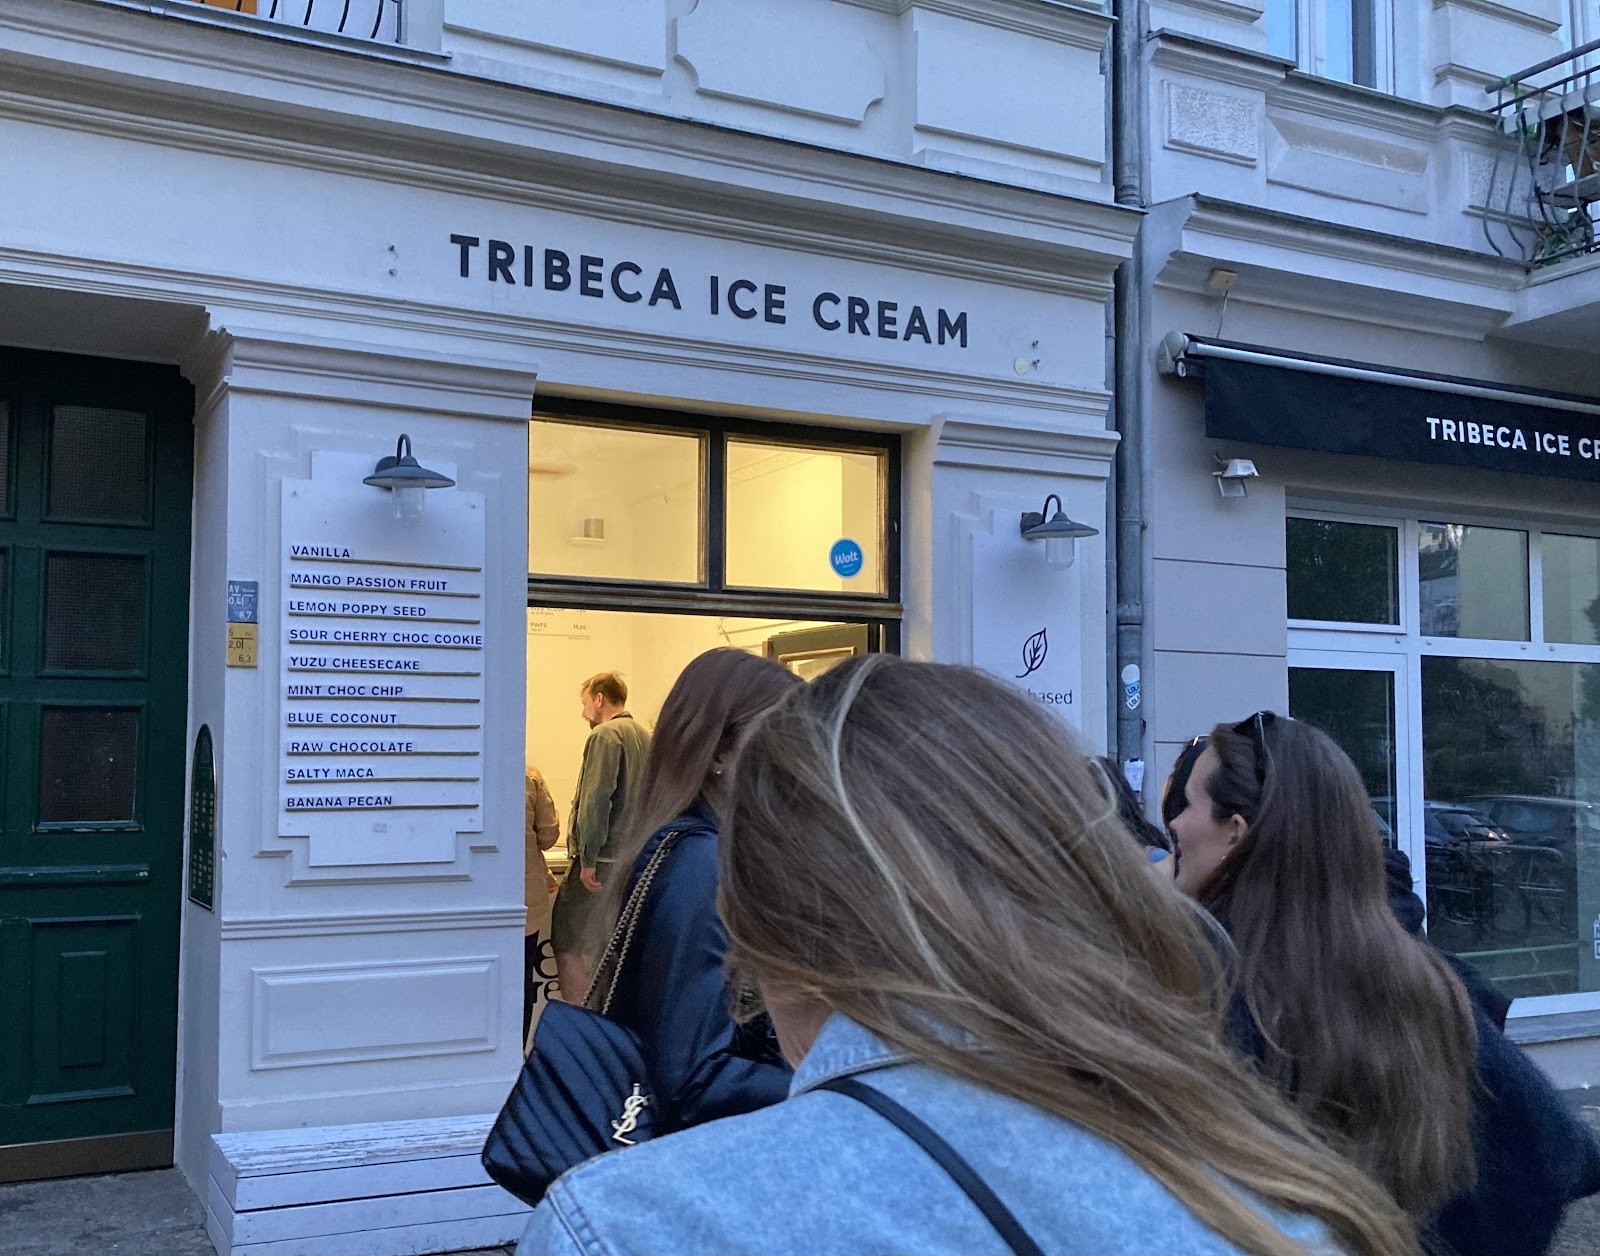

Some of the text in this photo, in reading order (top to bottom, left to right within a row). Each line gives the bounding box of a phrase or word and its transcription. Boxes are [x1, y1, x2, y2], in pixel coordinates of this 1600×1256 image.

[450, 233, 968, 348] TRIBECA ICE CREAM
[1426, 416, 1527, 451] TRIBECA
[1535, 431, 1571, 456] ICE
[292, 545, 351, 558] VANILLA
[834, 550, 859, 565] Wolt
[291, 573, 448, 591] MANGO PASSION FRUIT
[289, 600, 426, 617] LEMON POPPY SEED
[290, 629, 482, 645] SOUR CHERRY CHOC COOKIE
[290, 656, 420, 670] YUZU CHEESECAKE
[288, 685, 403, 696] MINT CHOC CHIP
[288, 712, 397, 724] BLUE COCONUT
[291, 742, 413, 752] RAW CHOCOLATE
[287, 767, 375, 779] SALTY MACA
[287, 796, 393, 808] BANANA PECAN
